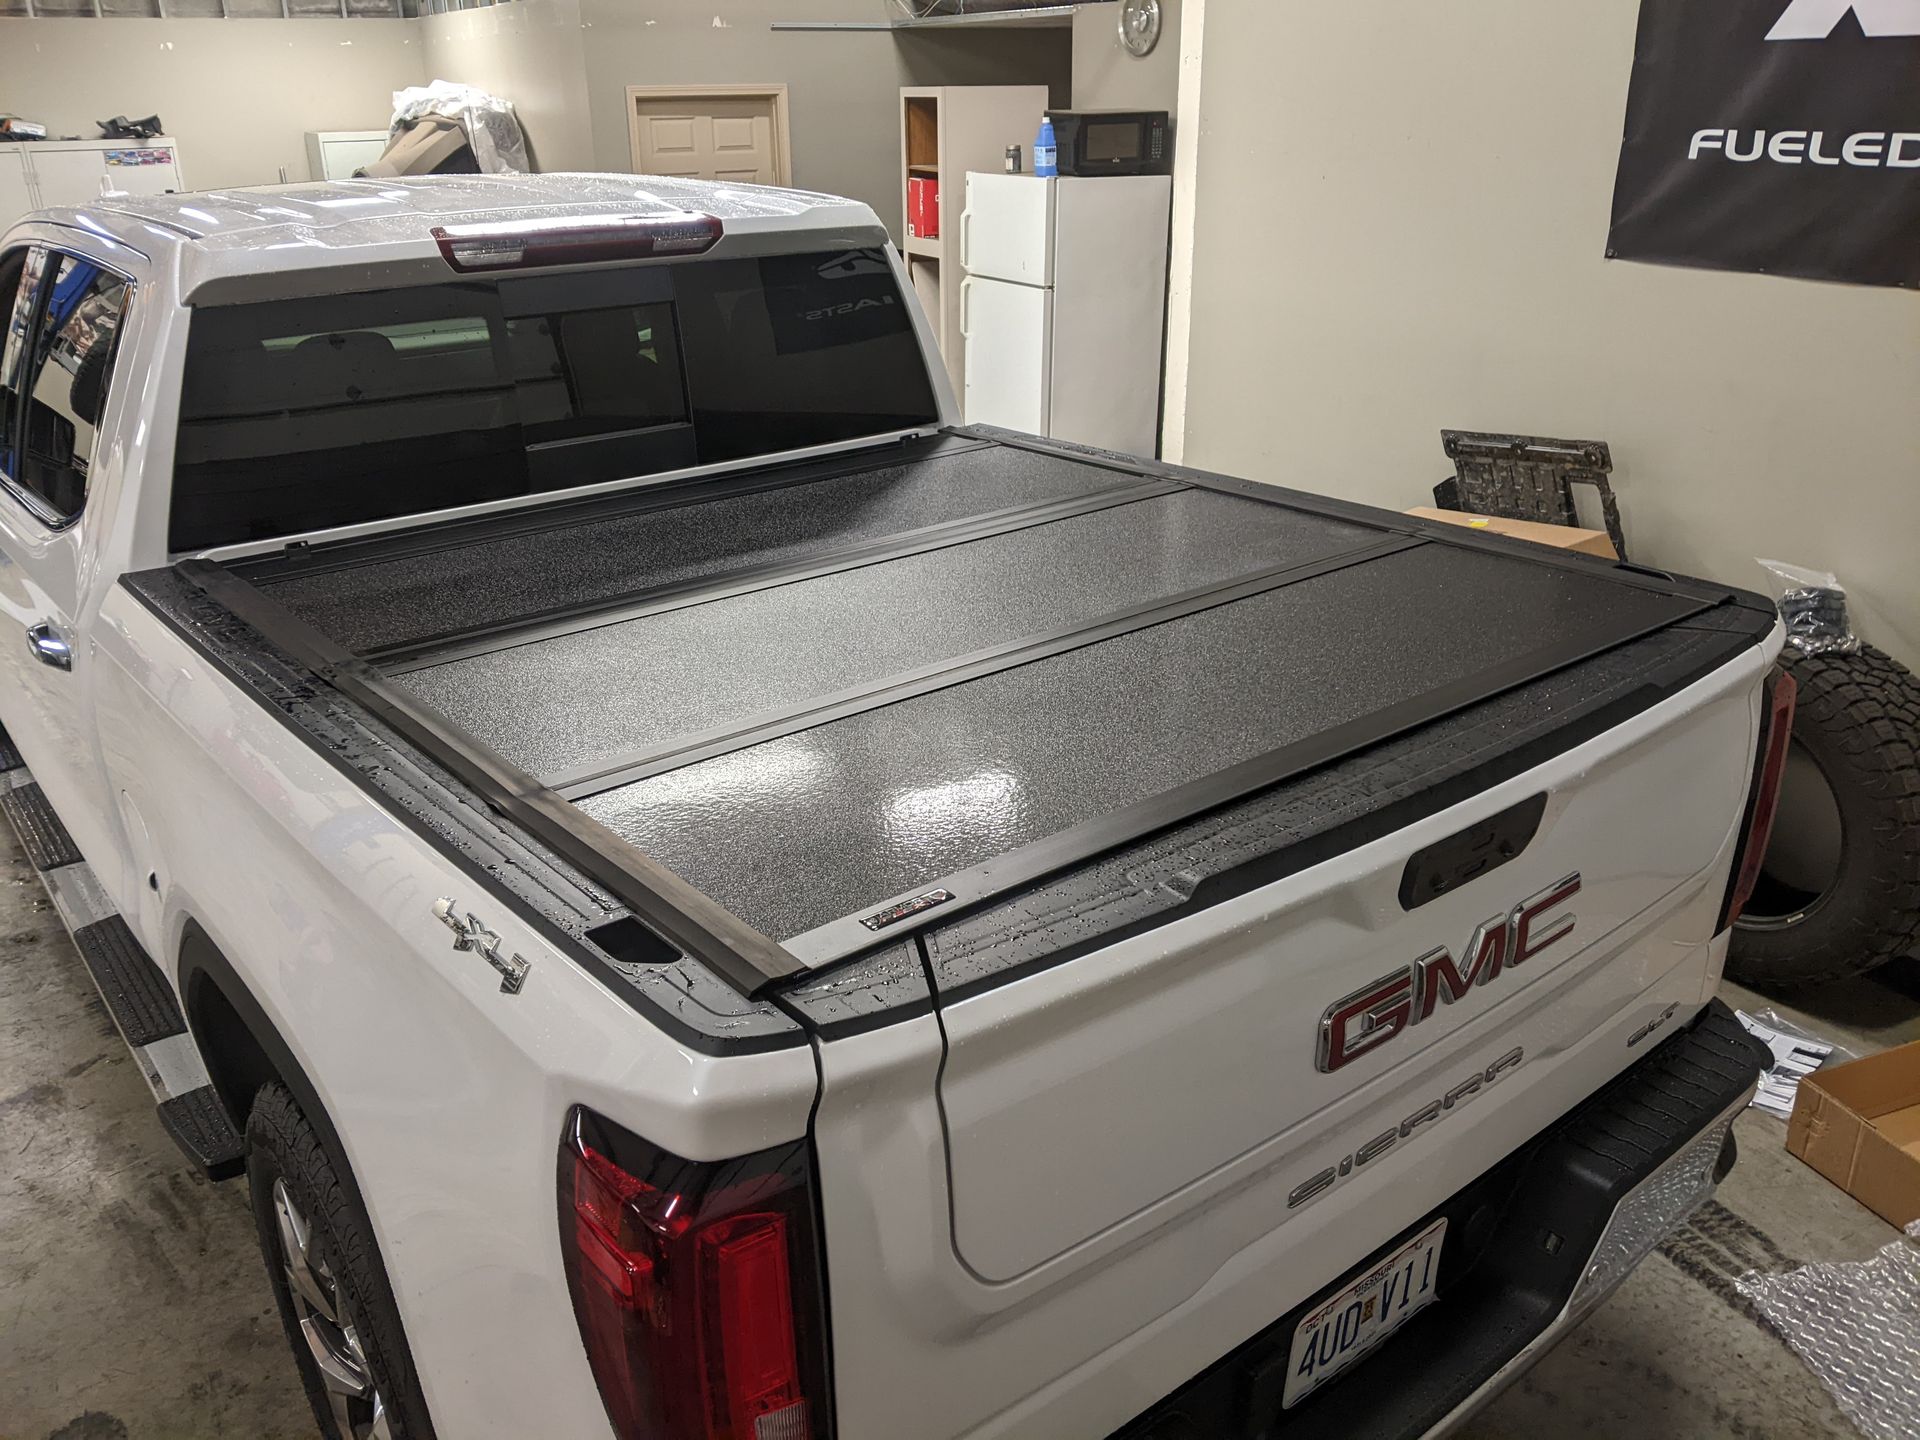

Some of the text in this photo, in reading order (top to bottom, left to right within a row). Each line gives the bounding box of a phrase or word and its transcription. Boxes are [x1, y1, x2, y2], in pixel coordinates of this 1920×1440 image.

[1687, 128, 1920, 168] FUELED
[1314, 870, 1583, 1074] GMC
[1287, 1046, 1525, 1210] SIERRA
[1297, 1245, 1435, 1378] 4UD V11
